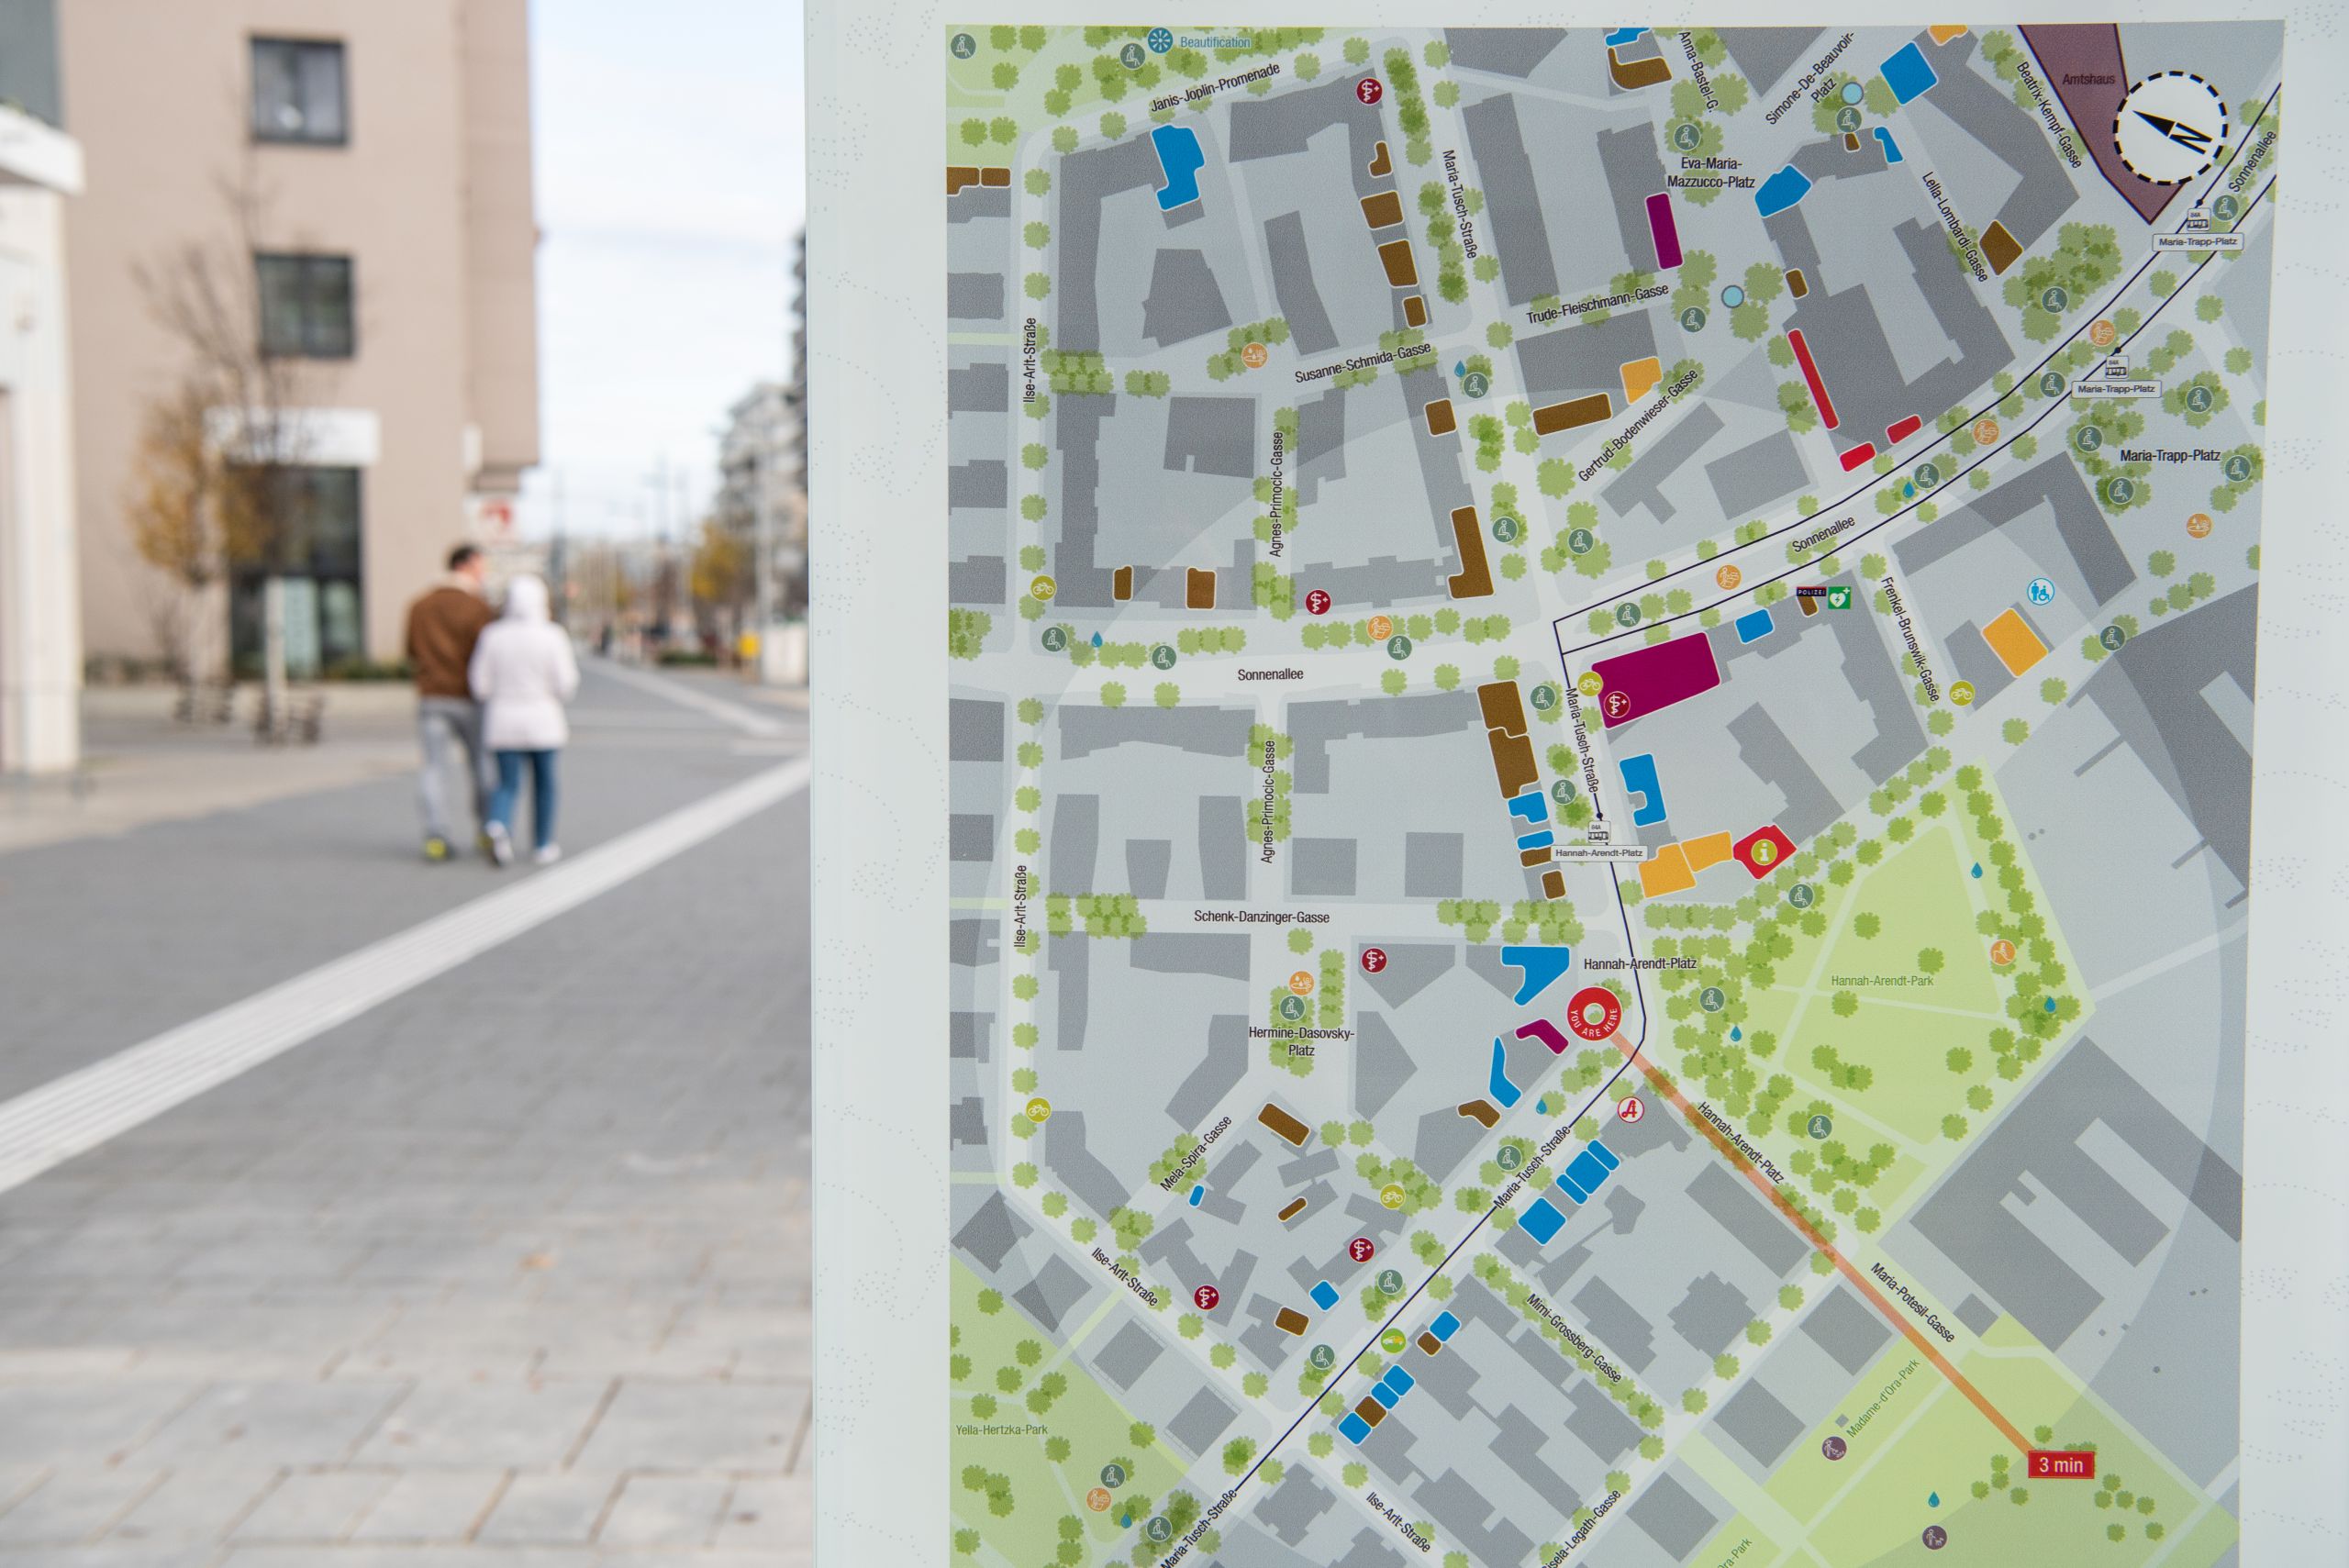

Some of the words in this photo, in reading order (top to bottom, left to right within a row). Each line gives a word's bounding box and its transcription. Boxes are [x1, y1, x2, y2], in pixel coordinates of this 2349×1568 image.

[1180, 35, 1250, 48] Beautification
[1151, 61, 1281, 112] Janis-Joplin-Promenade
[1678, 31, 1719, 114] Anna-Bastel-G.
[1765, 31, 1855, 125] Simone-De-Beauvoir-
[1811, 77, 1837, 104] Platz
[2063, 73, 2116, 85] Amtshaus
[2017, 61, 2081, 169] Beatrix-Kempf-Gasse
[1667, 176, 1755, 189] Mazzucco-Platz
[1681, 158, 1742, 170] Eva-Maria-
[2229, 129, 2277, 193] Sonnenallee
[1442, 149, 1476, 260] Maria-Tusch-Straße
[1922, 171, 1988, 283] Lella-Lombardi-Gasse
[2159, 237, 2237, 248] Maria-Trapp-Platz
[1527, 284, 1669, 325] Trude-Fleischmann-Gasse
[1022, 317, 1037, 404] Ilse-Arlt-Straße
[1295, 342, 1431, 384] Susanne-Schmida-Gasse
[2077, 384, 2155, 395] Maria-Trapp-Platz
[1578, 369, 1698, 483] Gertrud-Bodenwieser-Gasse
[2120, 450, 2221, 462] Maria-Trapp-Platz
[1270, 431, 1284, 558] Agnes-Primocic-Gasse
[1792, 516, 1855, 553] Sonnenallee
[1882, 576, 1940, 703] Frenkel-Brunswik-Gasse
[1237, 668, 1303, 682] Sonnenallee
[1565, 687, 1598, 794] Maria-Tusch-Straße
[1261, 740, 1275, 864] Agnes-Primocic-Gasse
[1555, 849, 1642, 858] Hannah-Arendt-Platz
[1014, 865, 1028, 949] Ilse-Arlt-Straße
[1194, 910, 1330, 924] Schenk-Danzinger-Gasse
[1584, 957, 1697, 970] Hannah-Arendt-Platz
[1831, 975, 1934, 986] Hannah-Arendt-Park
[1249, 1026, 1354, 1040] Hermine-Dasovsky-
[1571, 1009, 1580, 1028] YOU
[1582, 1028, 1602, 1038] ARE
[1603, 1007, 1618, 1032] HERE
[1288, 1045, 1315, 1057] Platz
[1160, 1116, 1231, 1192] Mela-Spira-Gasse
[1494, 1125, 1571, 1210] Maria-Tusch-Straße
[1698, 1101, 1785, 1184] Hannah-Arendt-Platz
[1091, 1247, 1158, 1307] Ilse-Arlt-Straße
[1870, 1262, 1955, 1343] Maria-Potesil-Gasse
[1527, 1293, 1622, 1384] Mimi-Grossberg-Gasse
[1846, 1358, 1921, 1439] Madame-d'Ora-Park
[956, 1424, 1048, 1436] Yella-Hertzka-Park
[2039, 1457, 2049, 1473] 3
[2054, 1457, 2083, 1473] min
[1366, 1492, 1431, 1553] Ilse-Arlt-Straße
